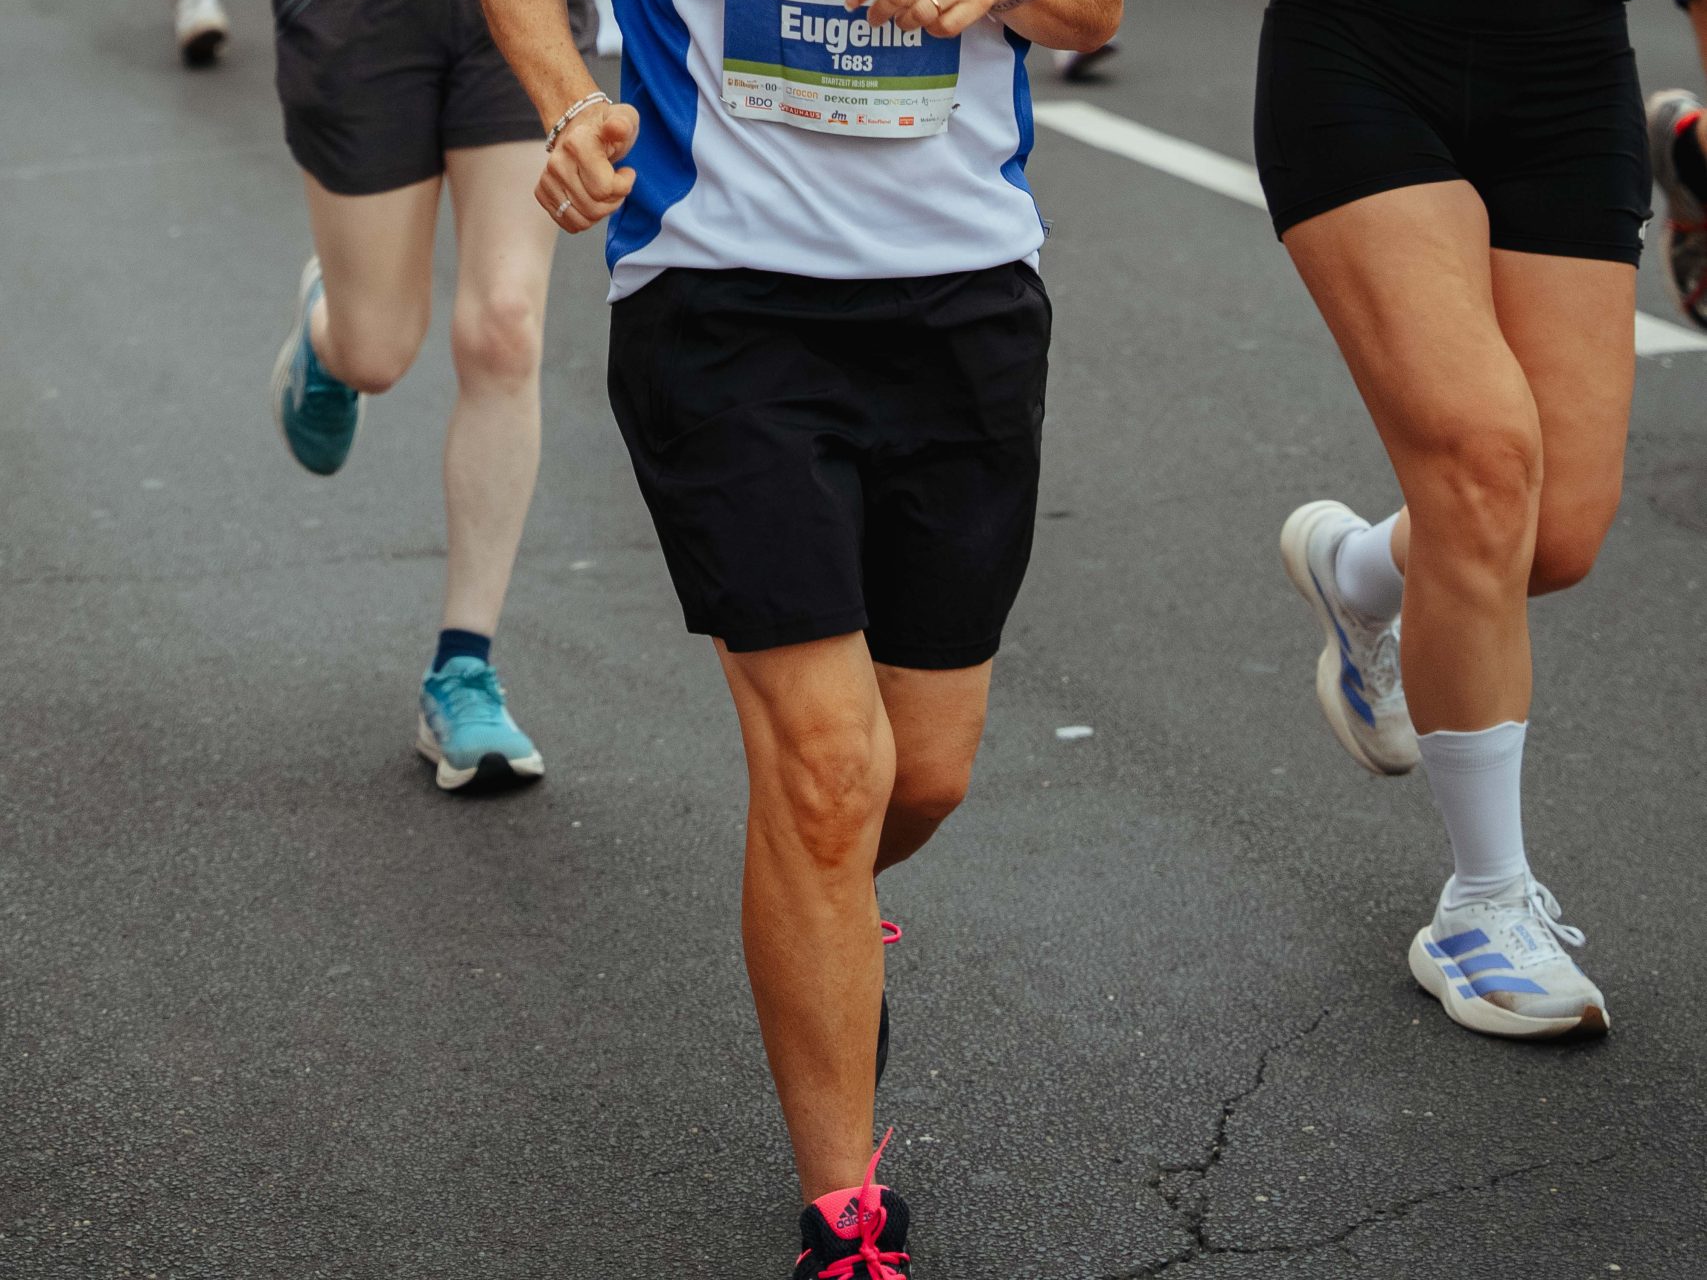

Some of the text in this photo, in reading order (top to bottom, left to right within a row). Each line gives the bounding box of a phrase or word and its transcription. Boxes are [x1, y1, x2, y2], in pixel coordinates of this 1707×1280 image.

[781, 4, 922, 54] Eugenia
[832, 54, 873, 71] 1683
[748, 96, 773, 108] BDO
[831, 110, 847, 121] dm
